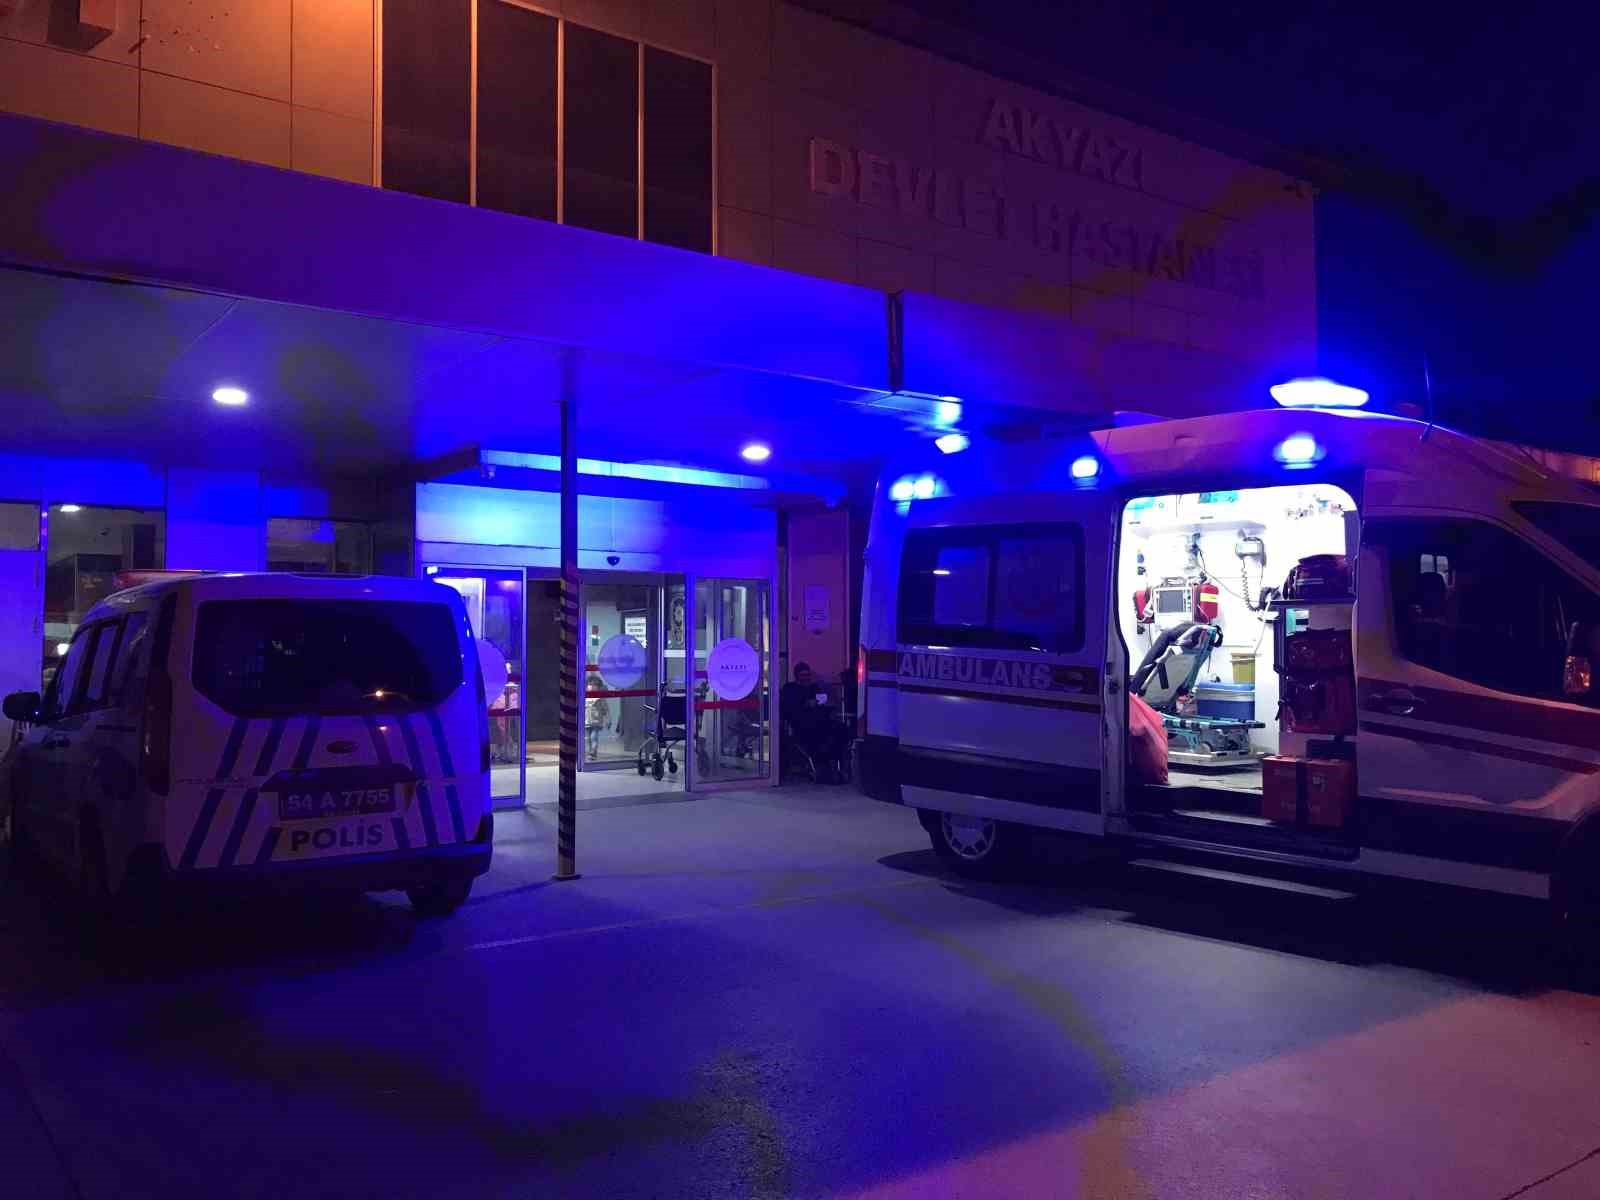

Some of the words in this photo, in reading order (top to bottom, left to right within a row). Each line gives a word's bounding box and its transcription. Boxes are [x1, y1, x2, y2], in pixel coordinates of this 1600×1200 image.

[981, 97, 1145, 192] AKYAZI
[808, 136, 1015, 240] DEVLET
[898, 653, 1052, 690] AMBULANS
[320, 791, 337, 808] A
